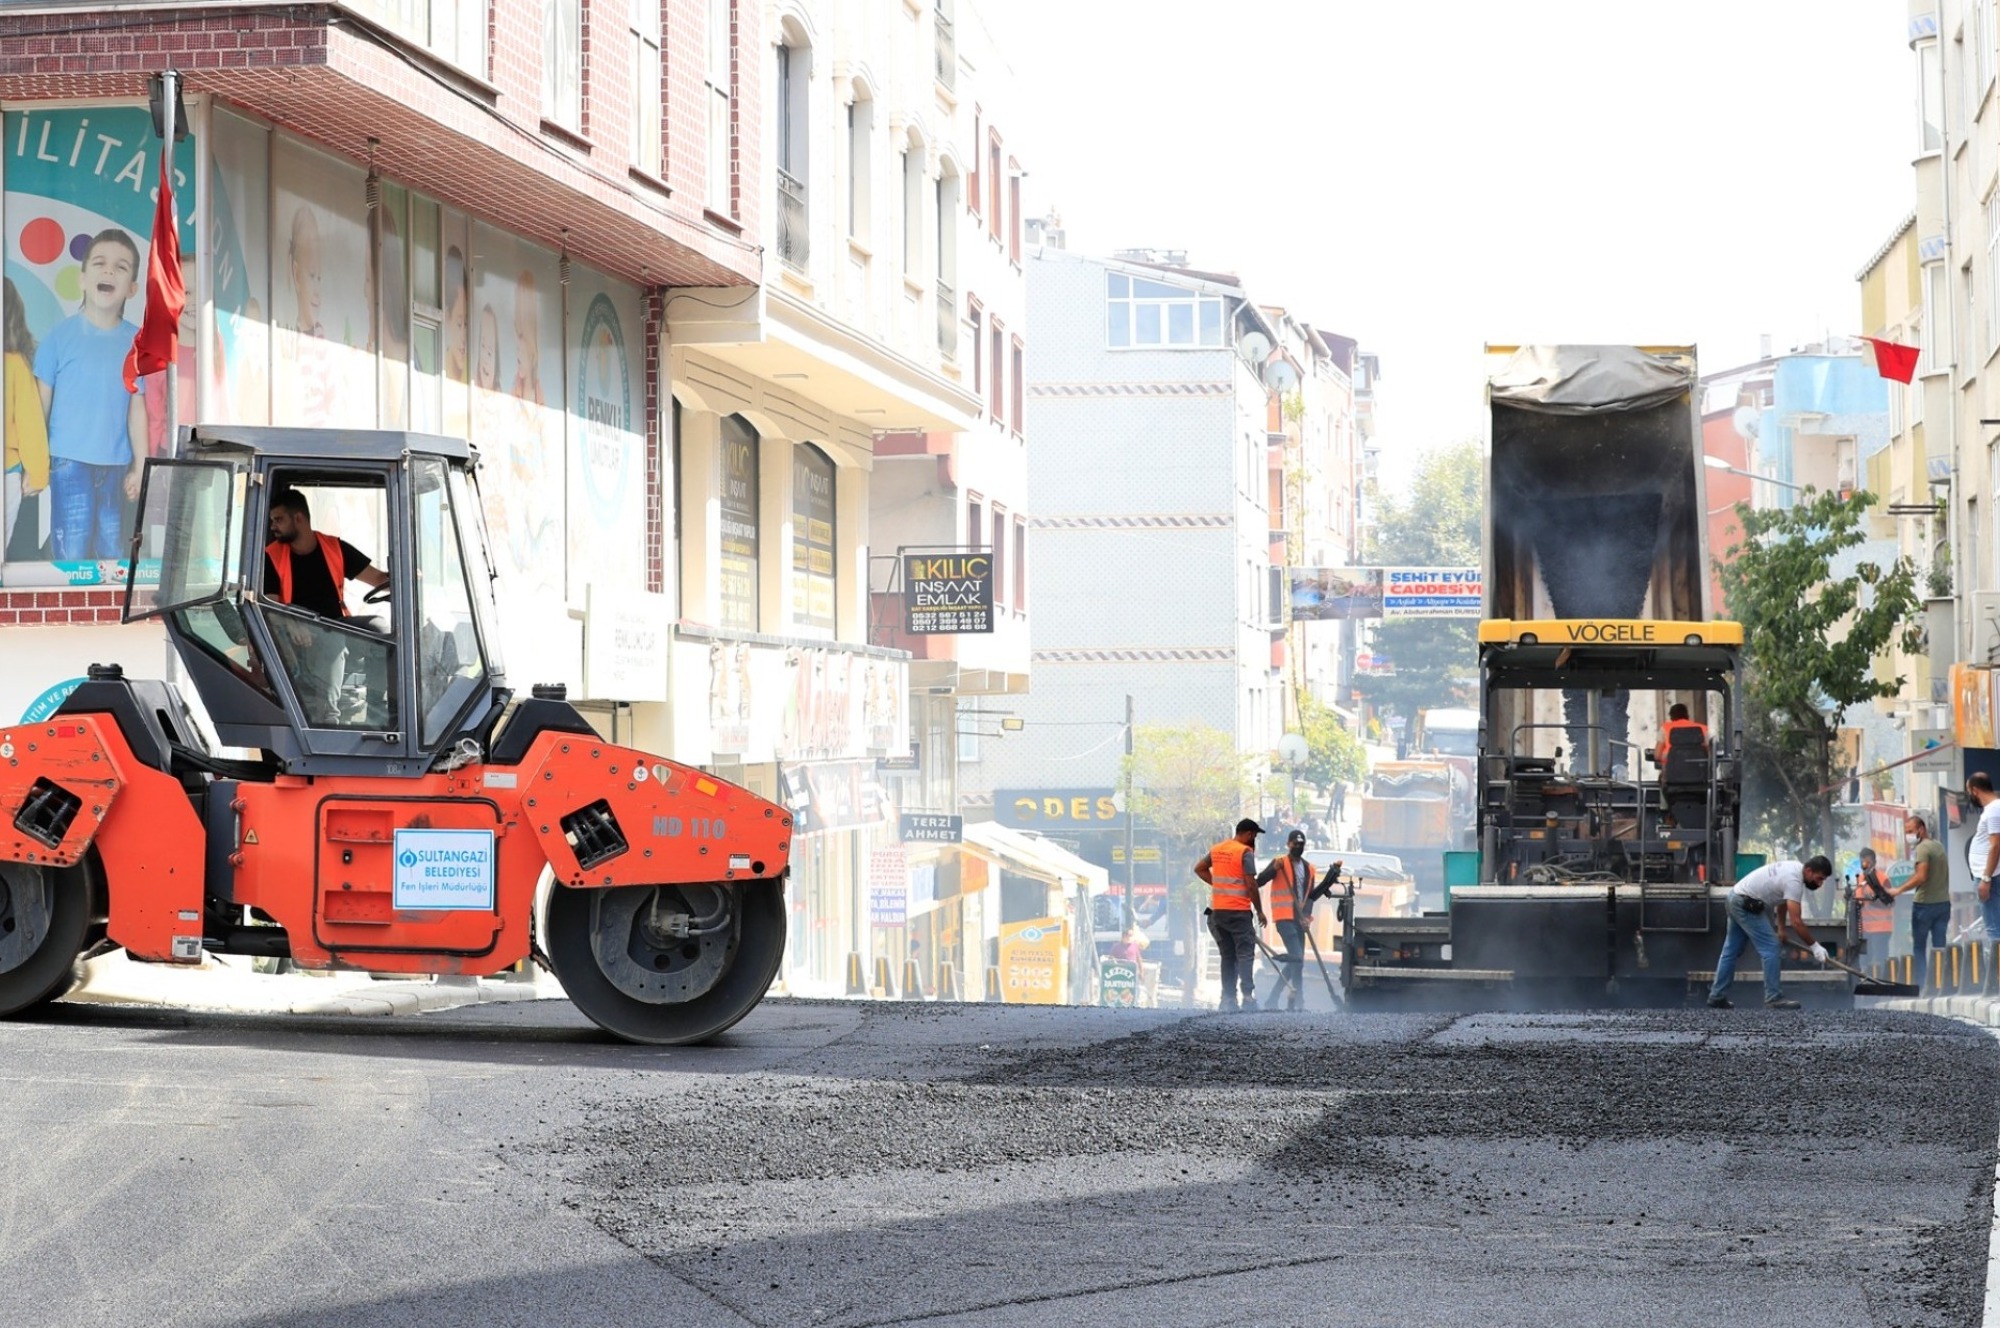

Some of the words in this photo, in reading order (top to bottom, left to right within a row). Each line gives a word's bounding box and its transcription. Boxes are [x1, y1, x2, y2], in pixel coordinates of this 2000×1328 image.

[65, 569, 93, 580] onus
[927, 557, 988, 580] KILIÇ
[917, 593, 981, 606] EMLAK
[1567, 621, 1655, 642] VÖGELE
[652, 816, 682, 837] HD
[690, 818, 725, 839] 110
[912, 816, 952, 828] TERZİ
[905, 830, 957, 840] AHMET
[418, 848, 488, 863] SULTANGAZİ
[425, 865, 481, 877] BELEDİYESİ
[401, 882, 416, 891] Fen
[441, 881, 488, 893] Müdürlüğü
